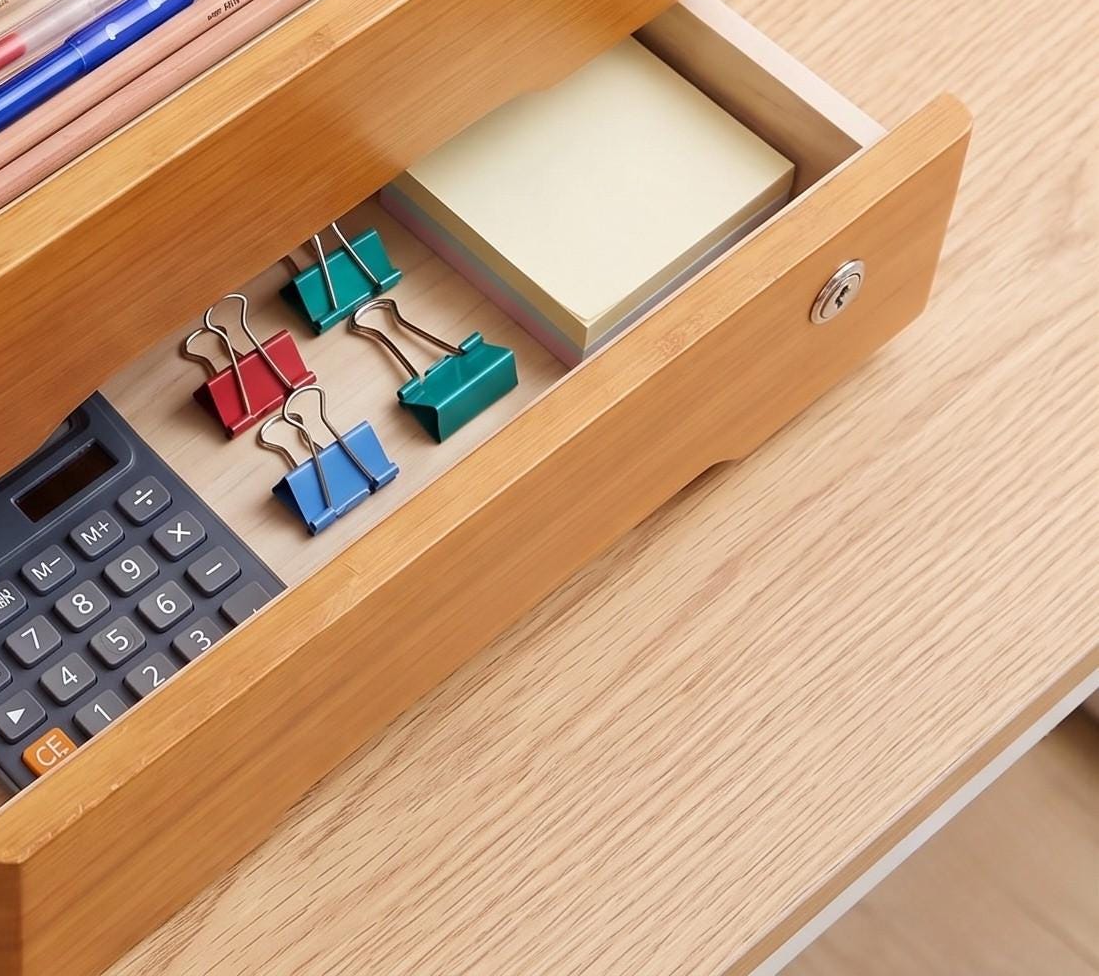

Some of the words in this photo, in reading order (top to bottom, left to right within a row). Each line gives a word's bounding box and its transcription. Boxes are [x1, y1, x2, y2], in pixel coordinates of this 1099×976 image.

[80, 520, 110, 546] M+
[120, 558, 142, 580] 9
[71, 593, 94, 615] 8
[156, 592, 177, 614] 6
[20, 626, 41, 650] 7
[105, 628, 129, 651] 5
[189, 629, 212, 651] 3
[60, 665, 79, 686] 4
[141, 665, 166, 688] 2
[93, 703, 113, 722] 1
[35, 734, 70, 767] CE
